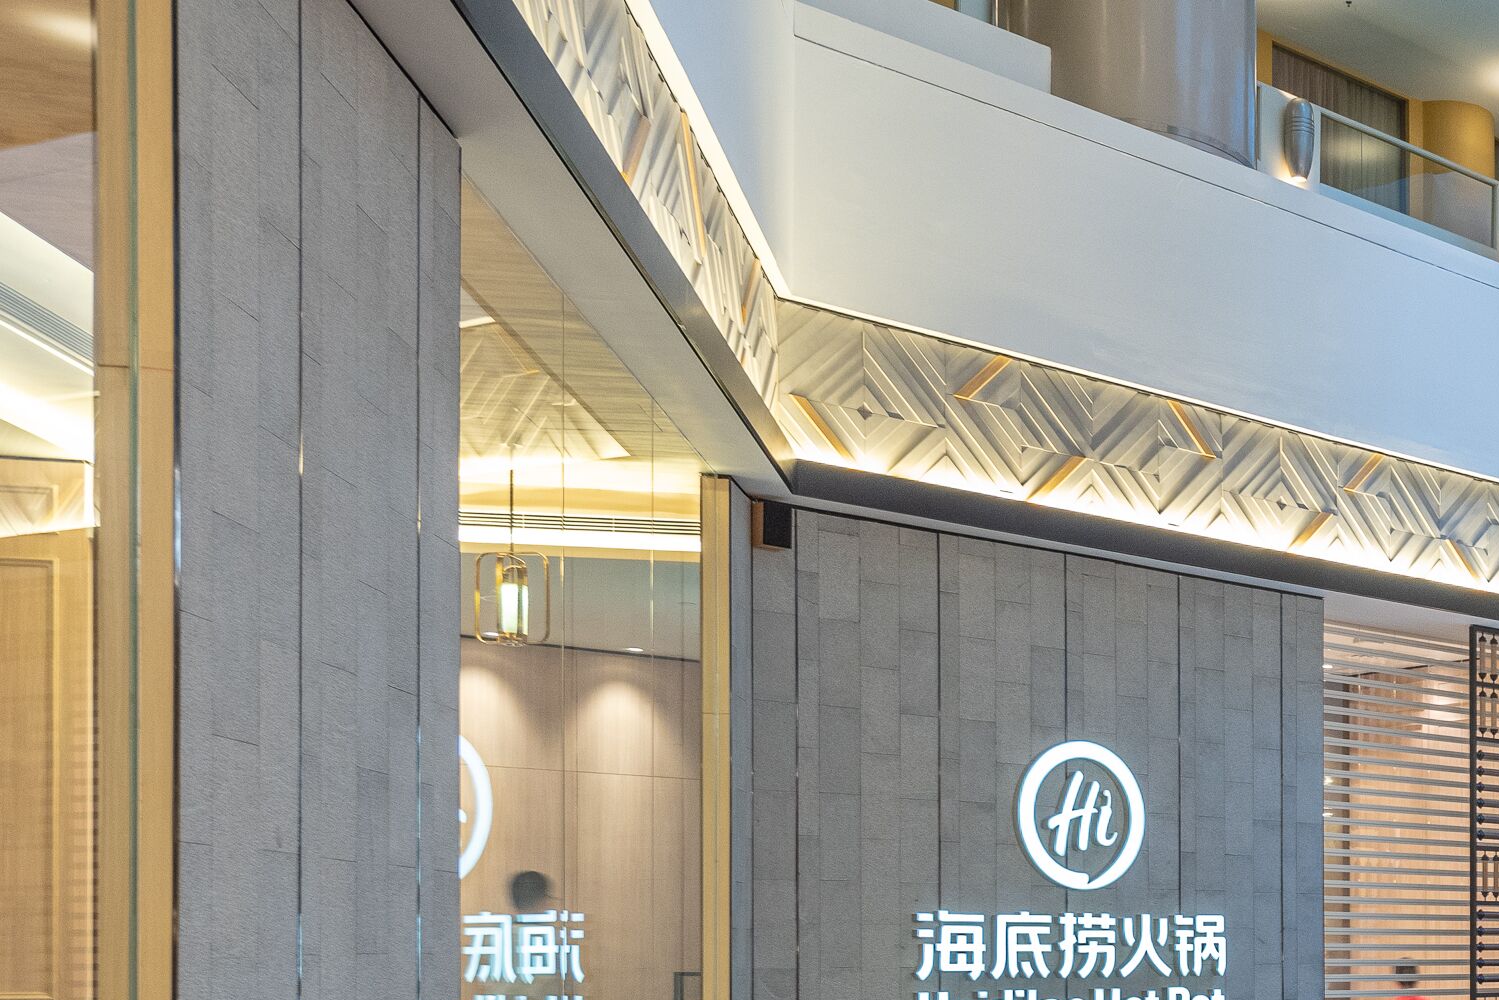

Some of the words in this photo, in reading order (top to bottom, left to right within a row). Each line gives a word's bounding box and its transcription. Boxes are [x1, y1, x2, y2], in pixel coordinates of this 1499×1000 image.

[1048, 770, 1119, 857] Hi
[915, 909, 1228, 981] 海底捞火锅
